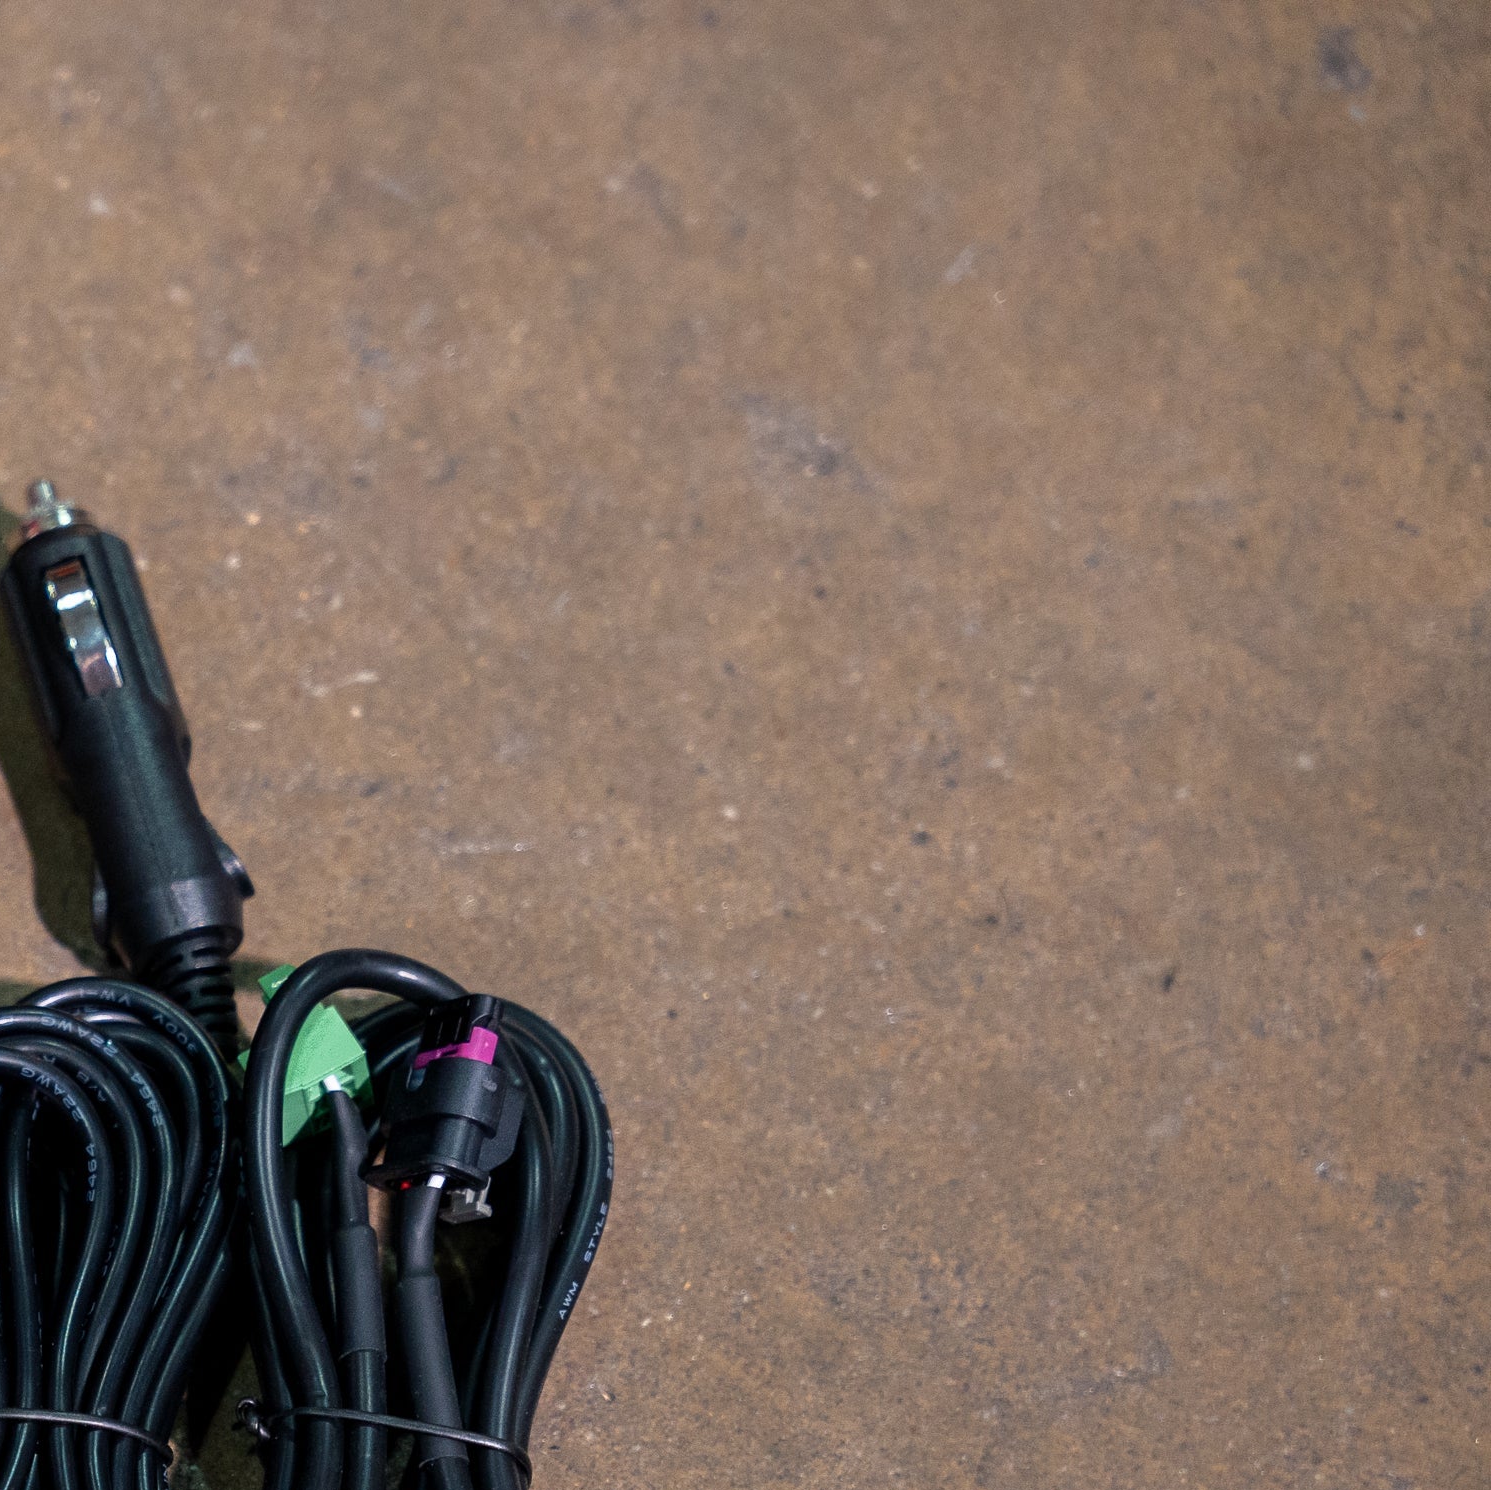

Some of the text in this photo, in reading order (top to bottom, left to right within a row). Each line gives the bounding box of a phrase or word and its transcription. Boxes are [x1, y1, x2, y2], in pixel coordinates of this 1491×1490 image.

[38, 1015, 119, 1059] 22AWG
[152, 1013, 196, 1055] 300V
[20, 1066, 84, 1123] 22AWG
[130, 1072, 166, 1128] 2464
[85, 1143, 97, 1202] 2464
[559, 1281, 579, 1321] AWM
[583, 1201, 609, 1263] STYLE
